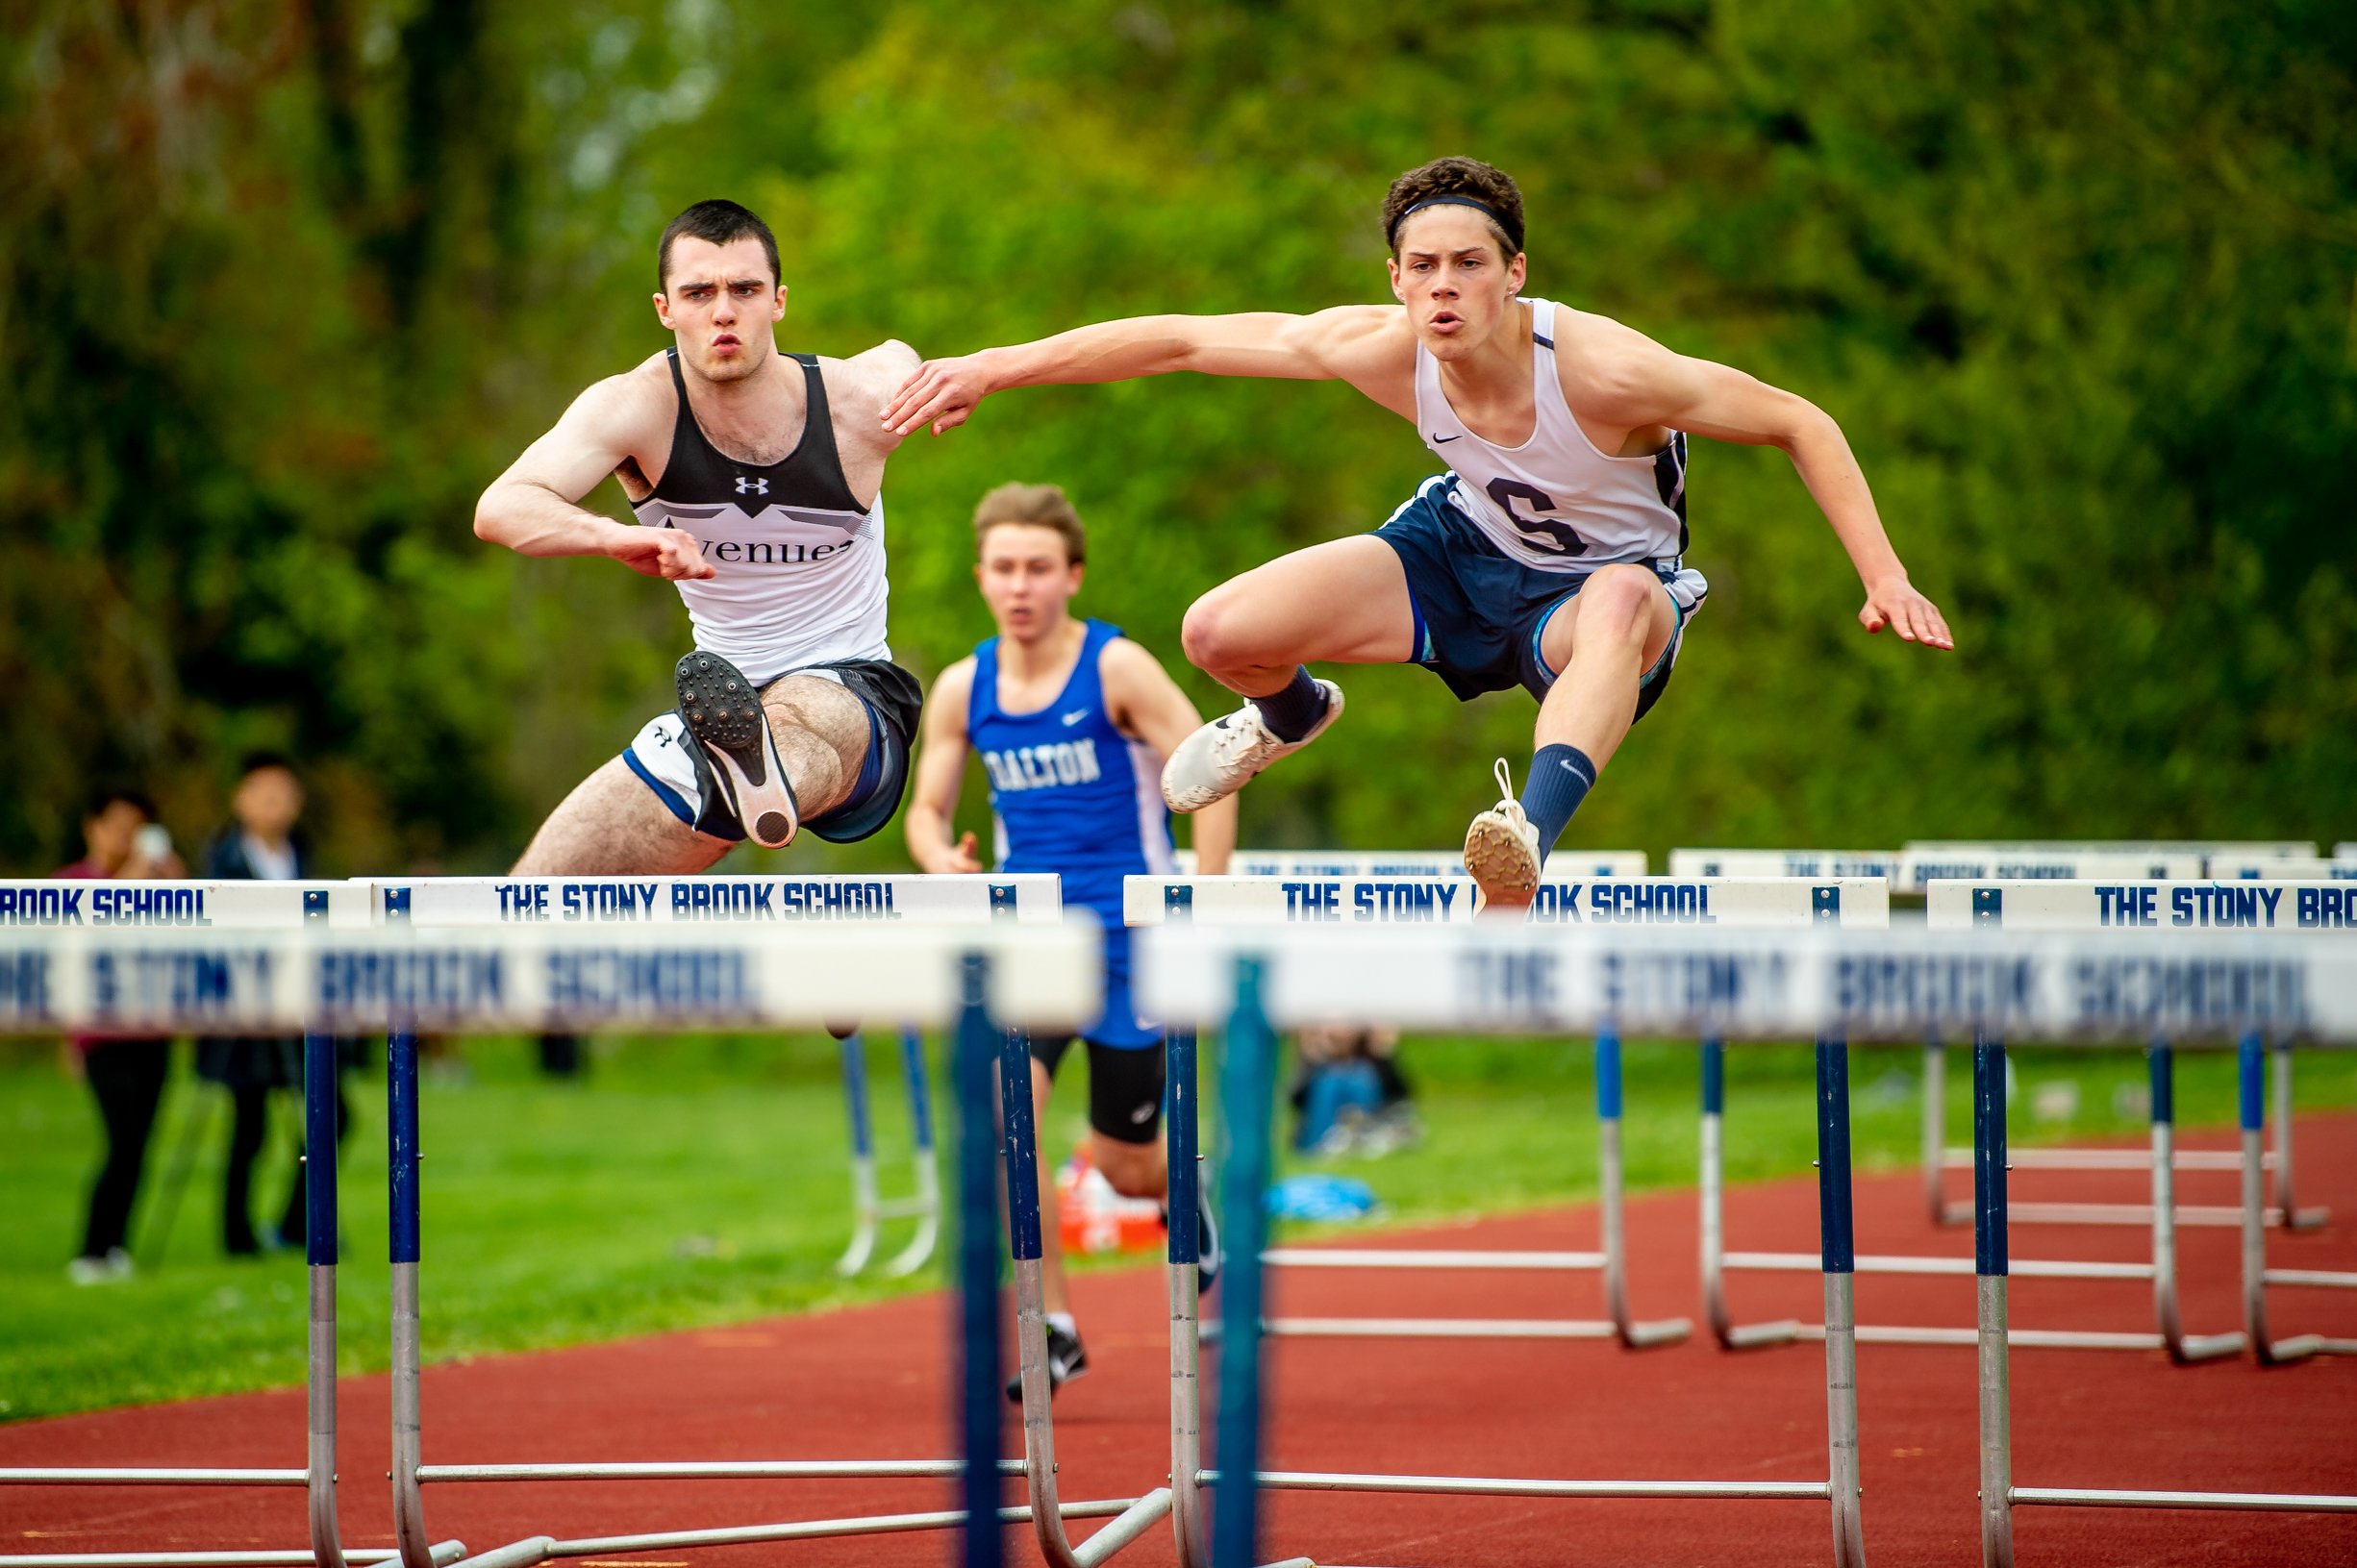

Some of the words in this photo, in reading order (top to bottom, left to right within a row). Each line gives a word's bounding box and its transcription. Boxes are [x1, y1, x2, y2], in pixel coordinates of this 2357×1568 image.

[1486, 477, 1589, 557] S
[92, 889, 213, 927] SCHOOL
[494, 884, 550, 922] THE
[563, 884, 658, 922] STONY
[672, 883, 776, 922] BROOK
[784, 882, 902, 921] SCHOOL
[1282, 884, 1341, 922] THE
[1354, 884, 1458, 923] STONY
[1592, 884, 1717, 924] SCHOOL
[2094, 886, 2158, 927] THE
[2171, 886, 2283, 928] STONY
